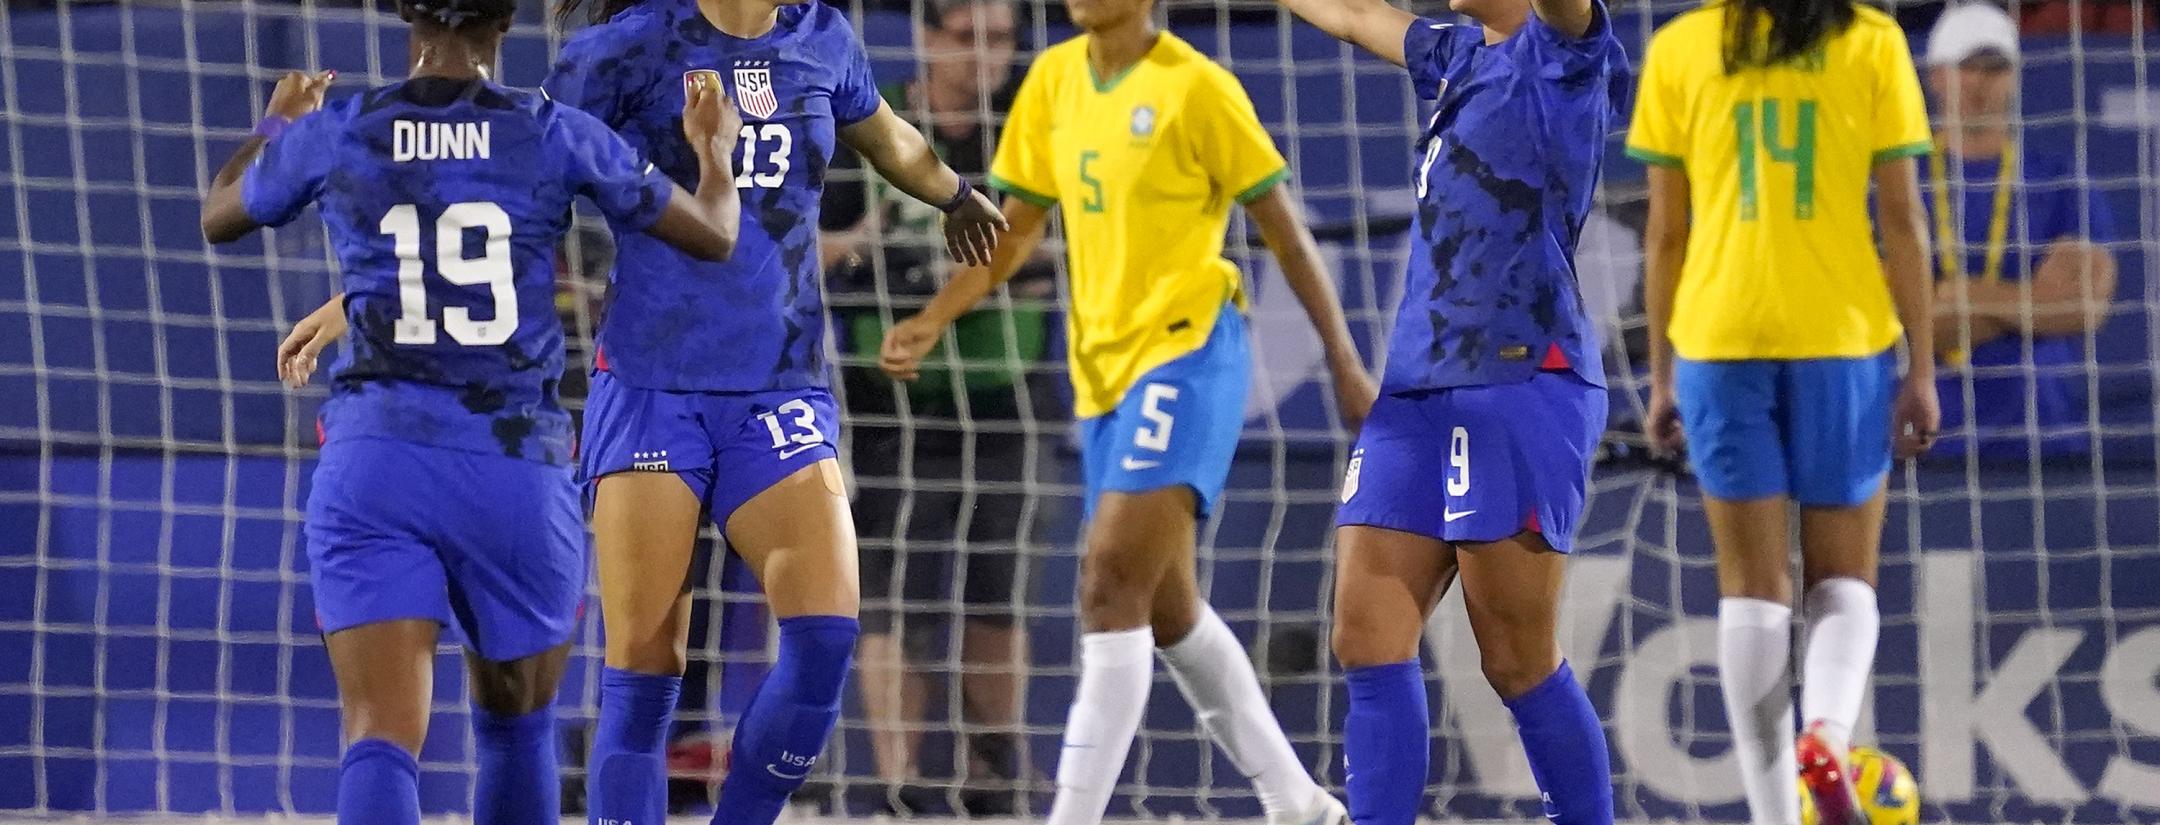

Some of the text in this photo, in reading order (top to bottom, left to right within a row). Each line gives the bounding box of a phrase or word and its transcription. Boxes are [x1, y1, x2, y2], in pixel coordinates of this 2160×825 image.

[737, 72, 768, 92] USA
[393, 119, 490, 161] DUNN
[735, 124, 792, 188] 13
[1734, 99, 1817, 221] 14
[1080, 150, 1103, 213] 5
[379, 201, 519, 346] 19
[757, 398, 824, 449] 13
[1134, 382, 1178, 452] 5
[1447, 426, 1470, 496] 9
[1421, 549, 2160, 806] Vok
[781, 750, 817, 767] USA
